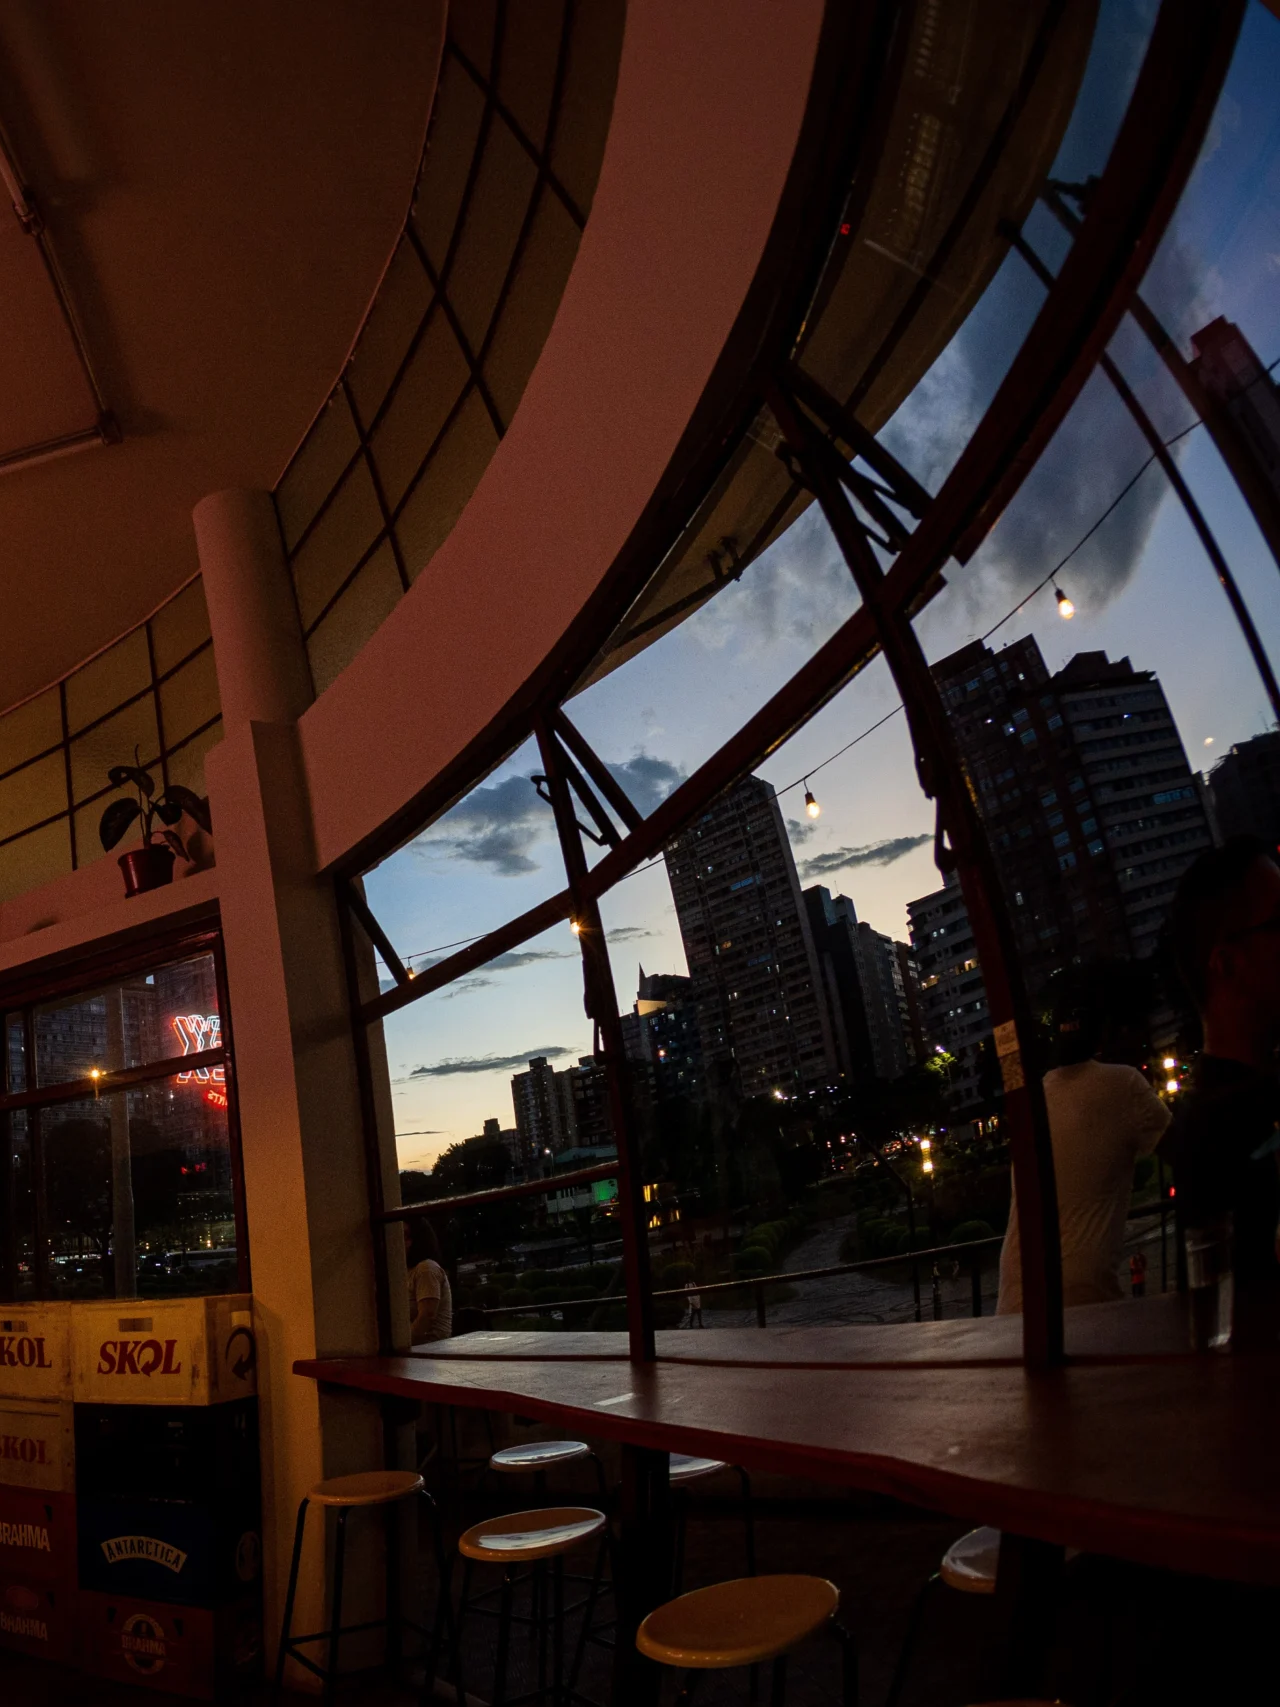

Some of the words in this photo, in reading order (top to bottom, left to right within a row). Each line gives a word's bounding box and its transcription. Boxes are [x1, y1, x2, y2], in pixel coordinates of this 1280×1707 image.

[97, 1339, 181, 1377] SKOL
[106, 1539, 182, 1569] ANTARCTICA
[0, 1611, 49, 1642] BRAHMA
